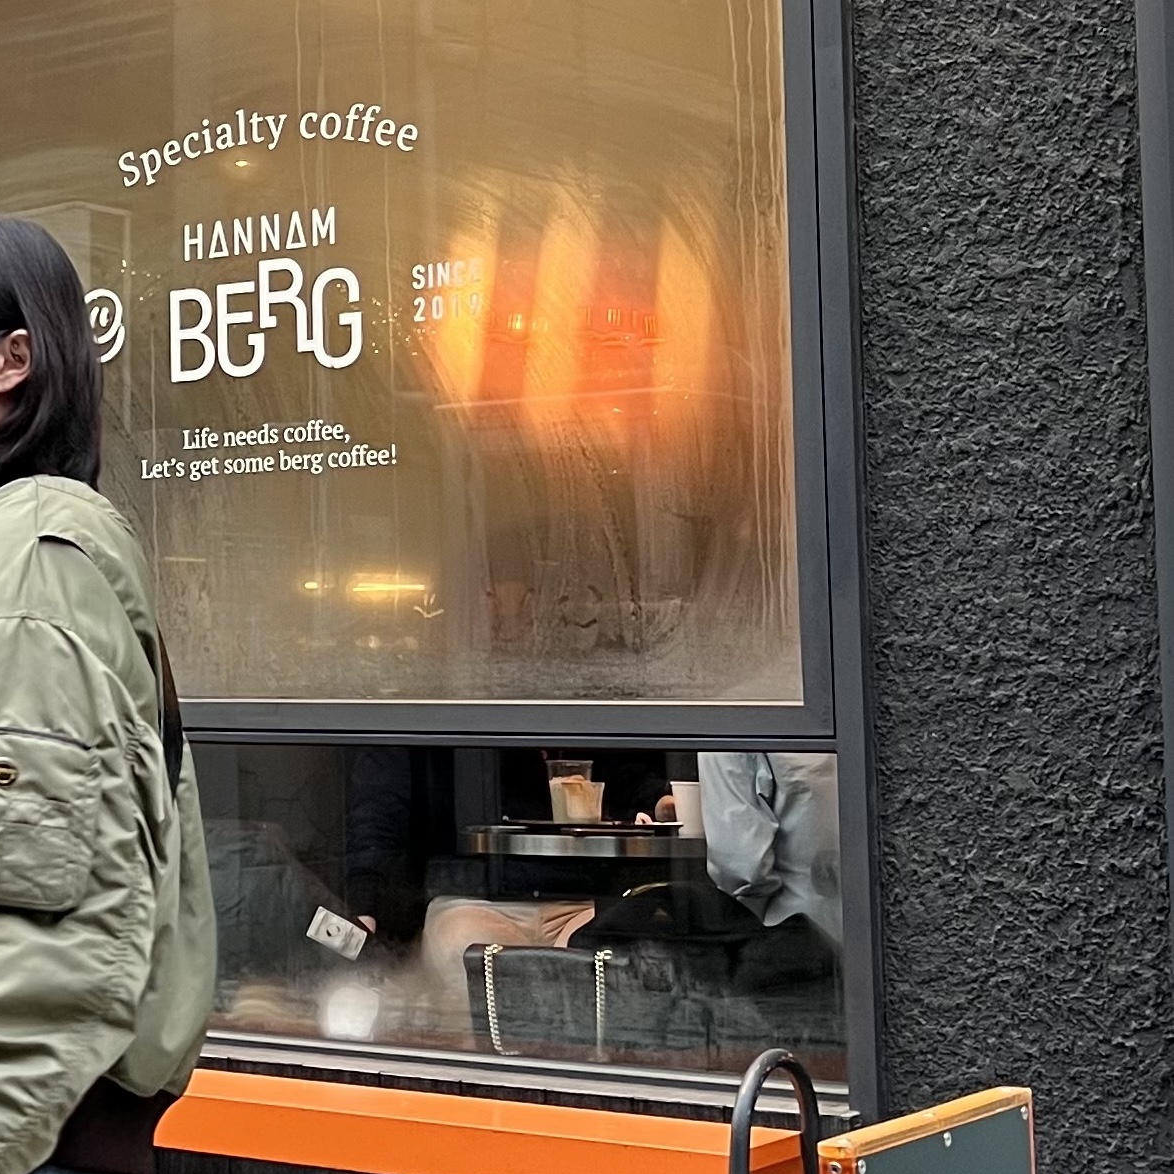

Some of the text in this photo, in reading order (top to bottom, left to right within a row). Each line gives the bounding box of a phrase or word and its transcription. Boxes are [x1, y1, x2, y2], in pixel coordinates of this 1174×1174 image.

[118, 103, 419, 187] Specialty coffee
[183, 206, 337, 262] HANNAM
[411, 259, 482, 290] SINCE
[169, 257, 363, 384] BERG
[182, 420, 351, 450] Life needs coffee,
[141, 444, 397, 481] Let's get some berg coffee!
